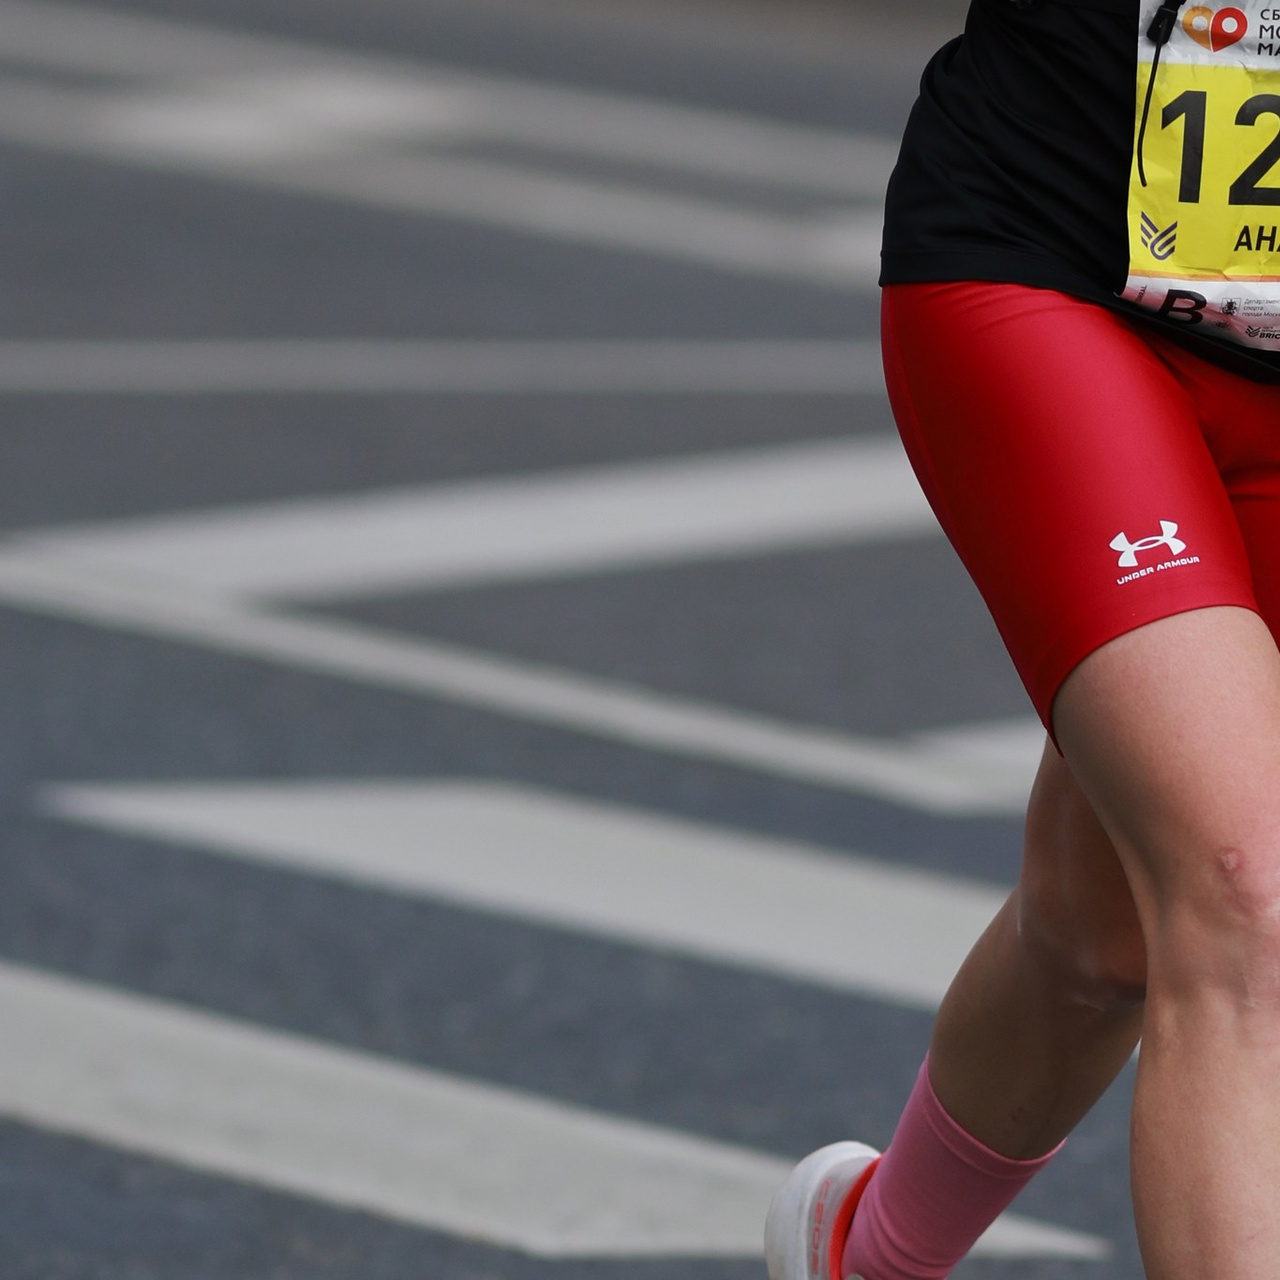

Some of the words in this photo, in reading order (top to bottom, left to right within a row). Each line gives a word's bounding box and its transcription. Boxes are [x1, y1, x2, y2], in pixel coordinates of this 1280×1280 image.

[1156, 288, 1208, 325] B
[1117, 566, 1155, 585] UNDER
[1156, 556, 1200, 572] ARMOUR
